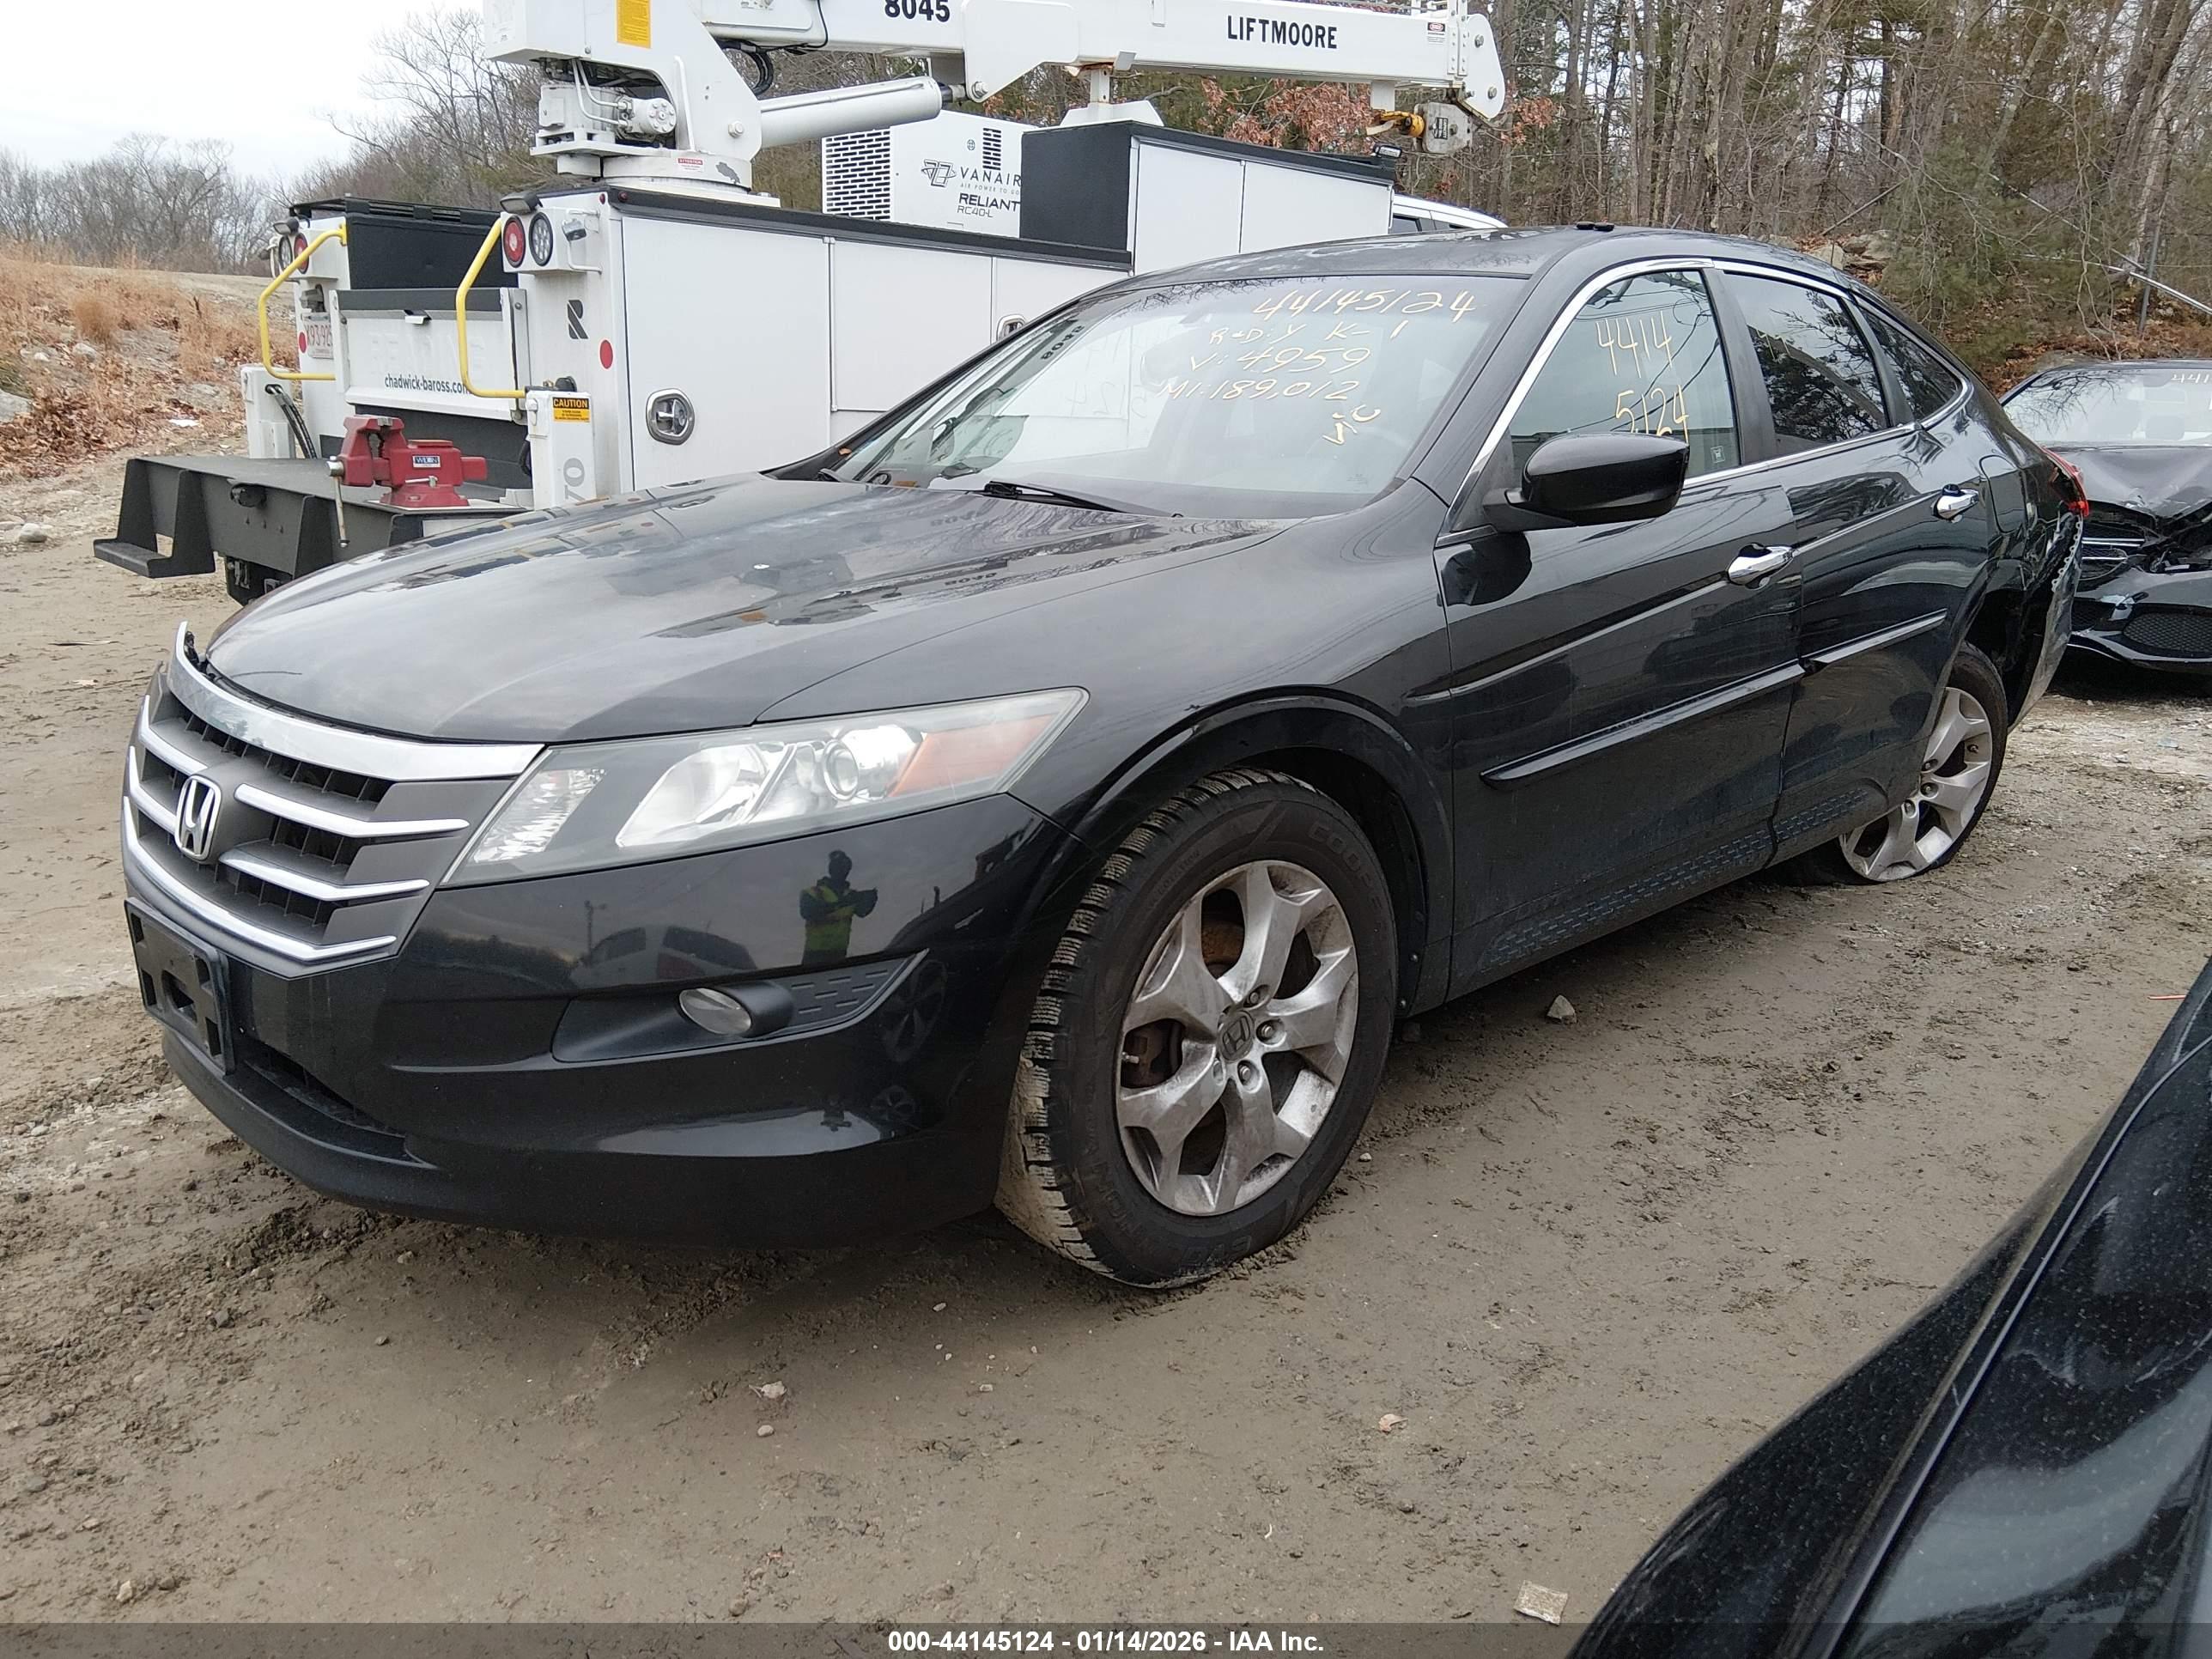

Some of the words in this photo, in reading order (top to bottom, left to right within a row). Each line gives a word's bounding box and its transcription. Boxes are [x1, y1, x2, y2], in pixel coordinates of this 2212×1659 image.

[885, 0, 950, 22] 8045
[1227, 15, 1337, 49] LIFTMOORE
[960, 166, 1021, 186] VANAIR
[975, 184, 996, 192] POWER
[957, 205, 994, 218] RC40-L
[959, 192, 1021, 212] RELIANT
[1253, 288, 1476, 323] 44145124
[1595, 310, 1673, 379] 4414
[1237, 346, 1371, 374] 4959
[553, 398, 589, 408] CAUTION
